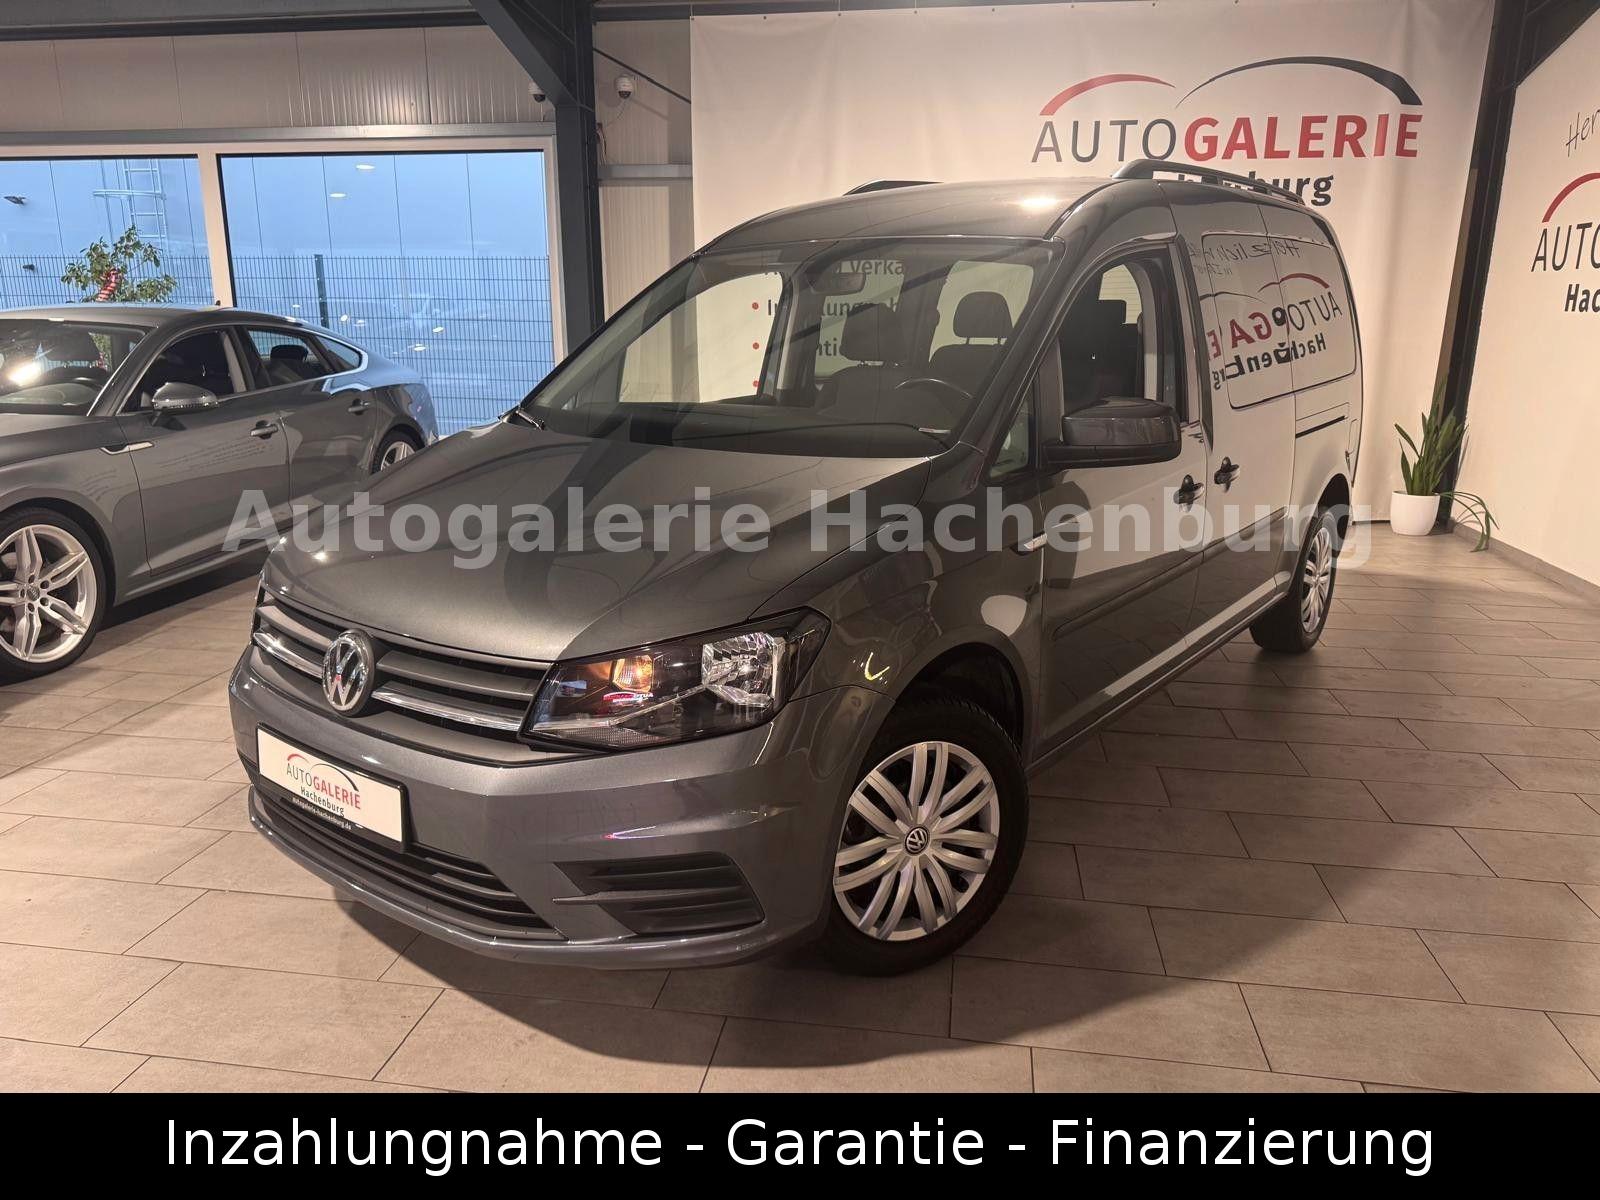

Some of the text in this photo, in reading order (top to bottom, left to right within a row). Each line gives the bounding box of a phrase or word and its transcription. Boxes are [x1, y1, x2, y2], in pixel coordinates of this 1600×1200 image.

[1031, 114, 1423, 163] AUTOGALERIE
[286, 763, 361, 810] AUTOGALERIE
[300, 786, 345, 817] Hachenburg
